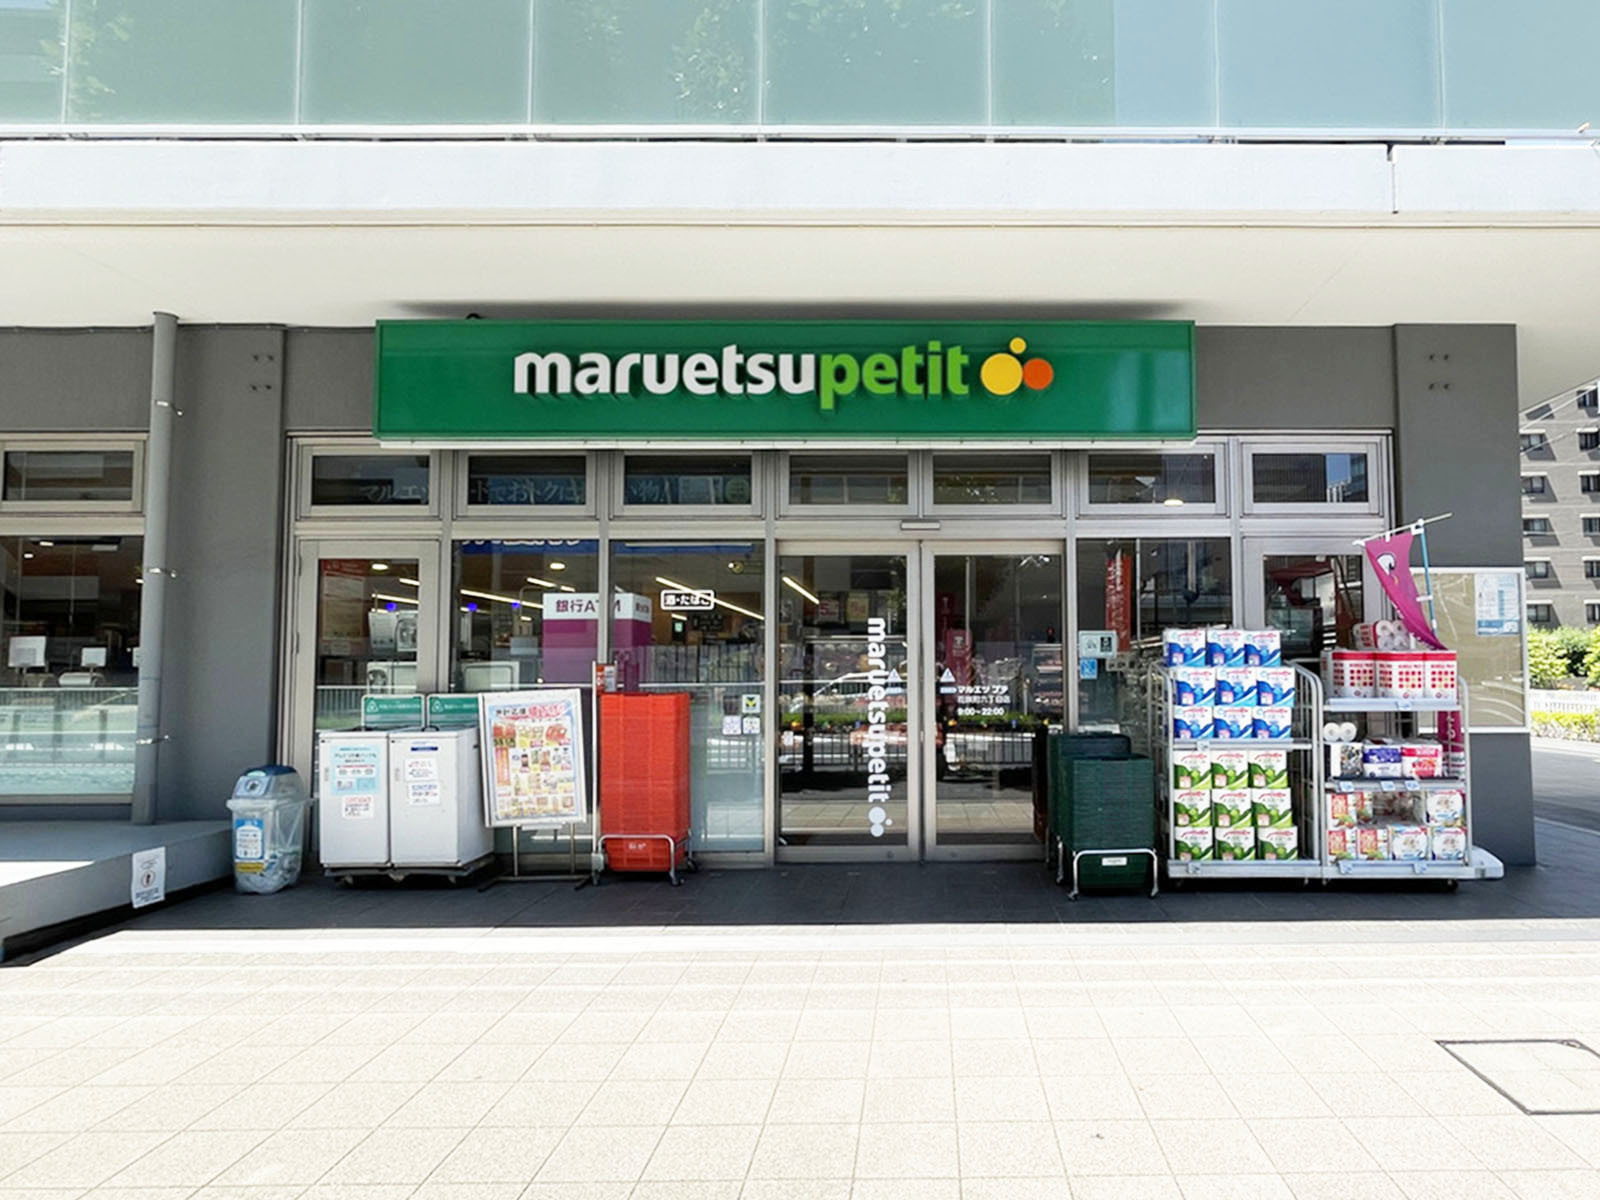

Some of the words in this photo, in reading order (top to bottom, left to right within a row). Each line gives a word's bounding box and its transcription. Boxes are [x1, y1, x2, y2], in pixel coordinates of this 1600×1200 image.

[513, 340, 970, 410] maruetsupetit
[555, 599, 621, 613] 銀行AM
[862, 618, 892, 802] maruetsupetit
